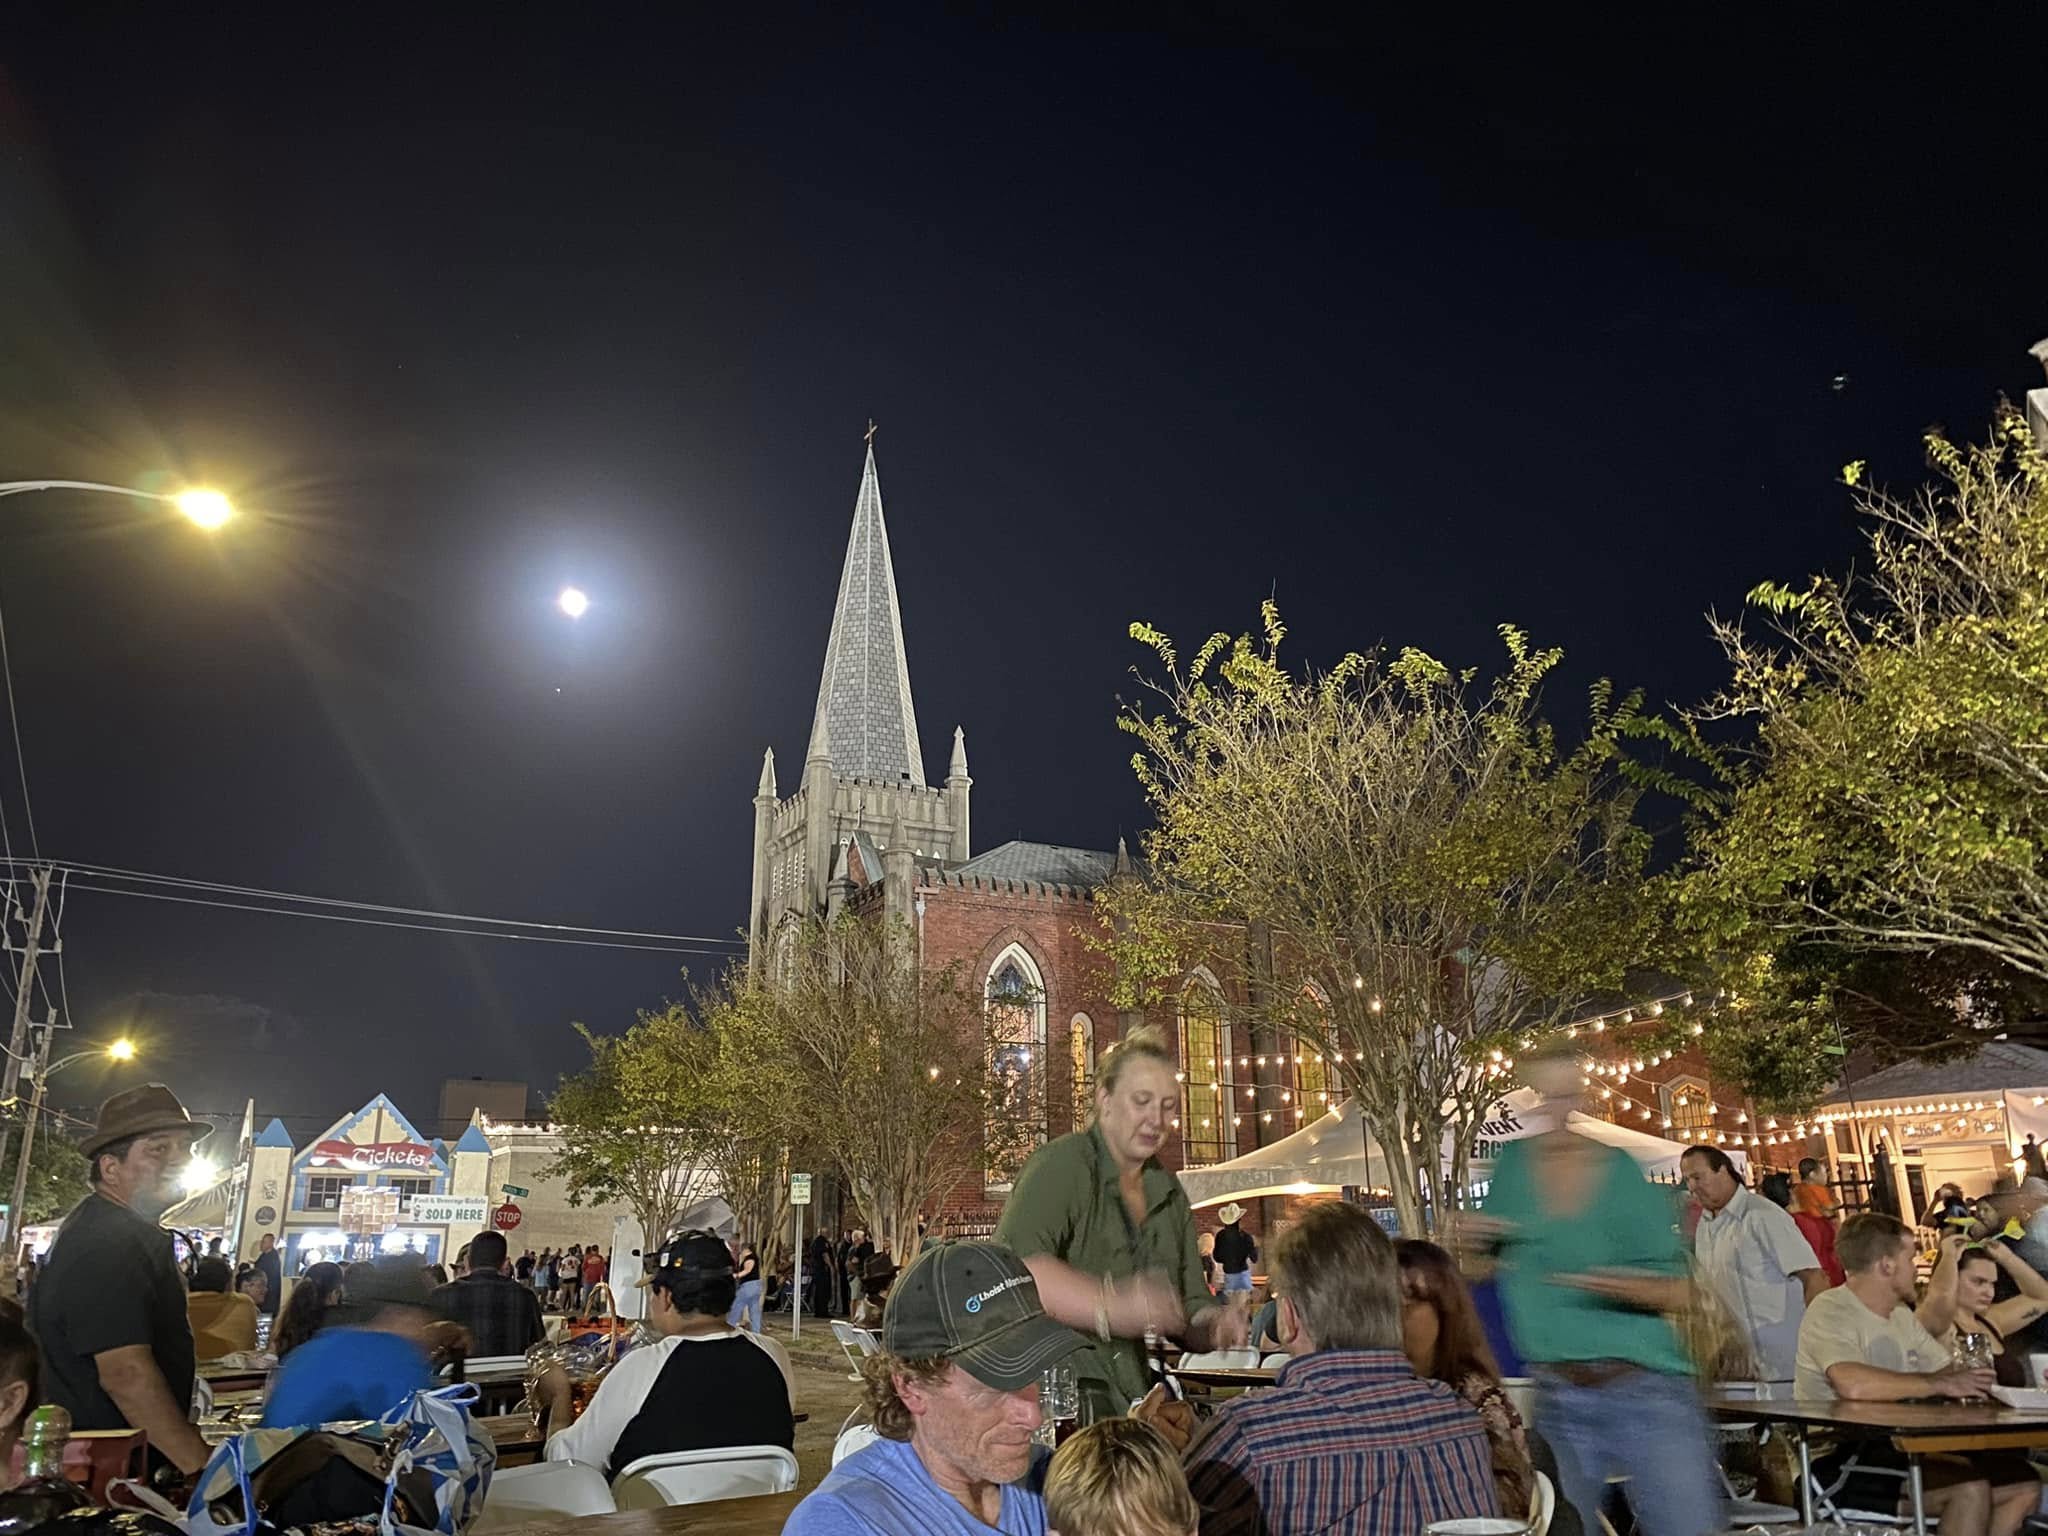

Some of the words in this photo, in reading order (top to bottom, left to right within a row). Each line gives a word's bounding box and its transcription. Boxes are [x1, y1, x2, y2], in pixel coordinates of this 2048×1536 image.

[353, 1146, 426, 1167] Tickets
[425, 1208, 452, 1220] SOLD
[455, 1208, 484, 1220] HERE
[496, 1211, 520, 1223] STOP
[979, 1282, 1006, 1302] Lhoist
